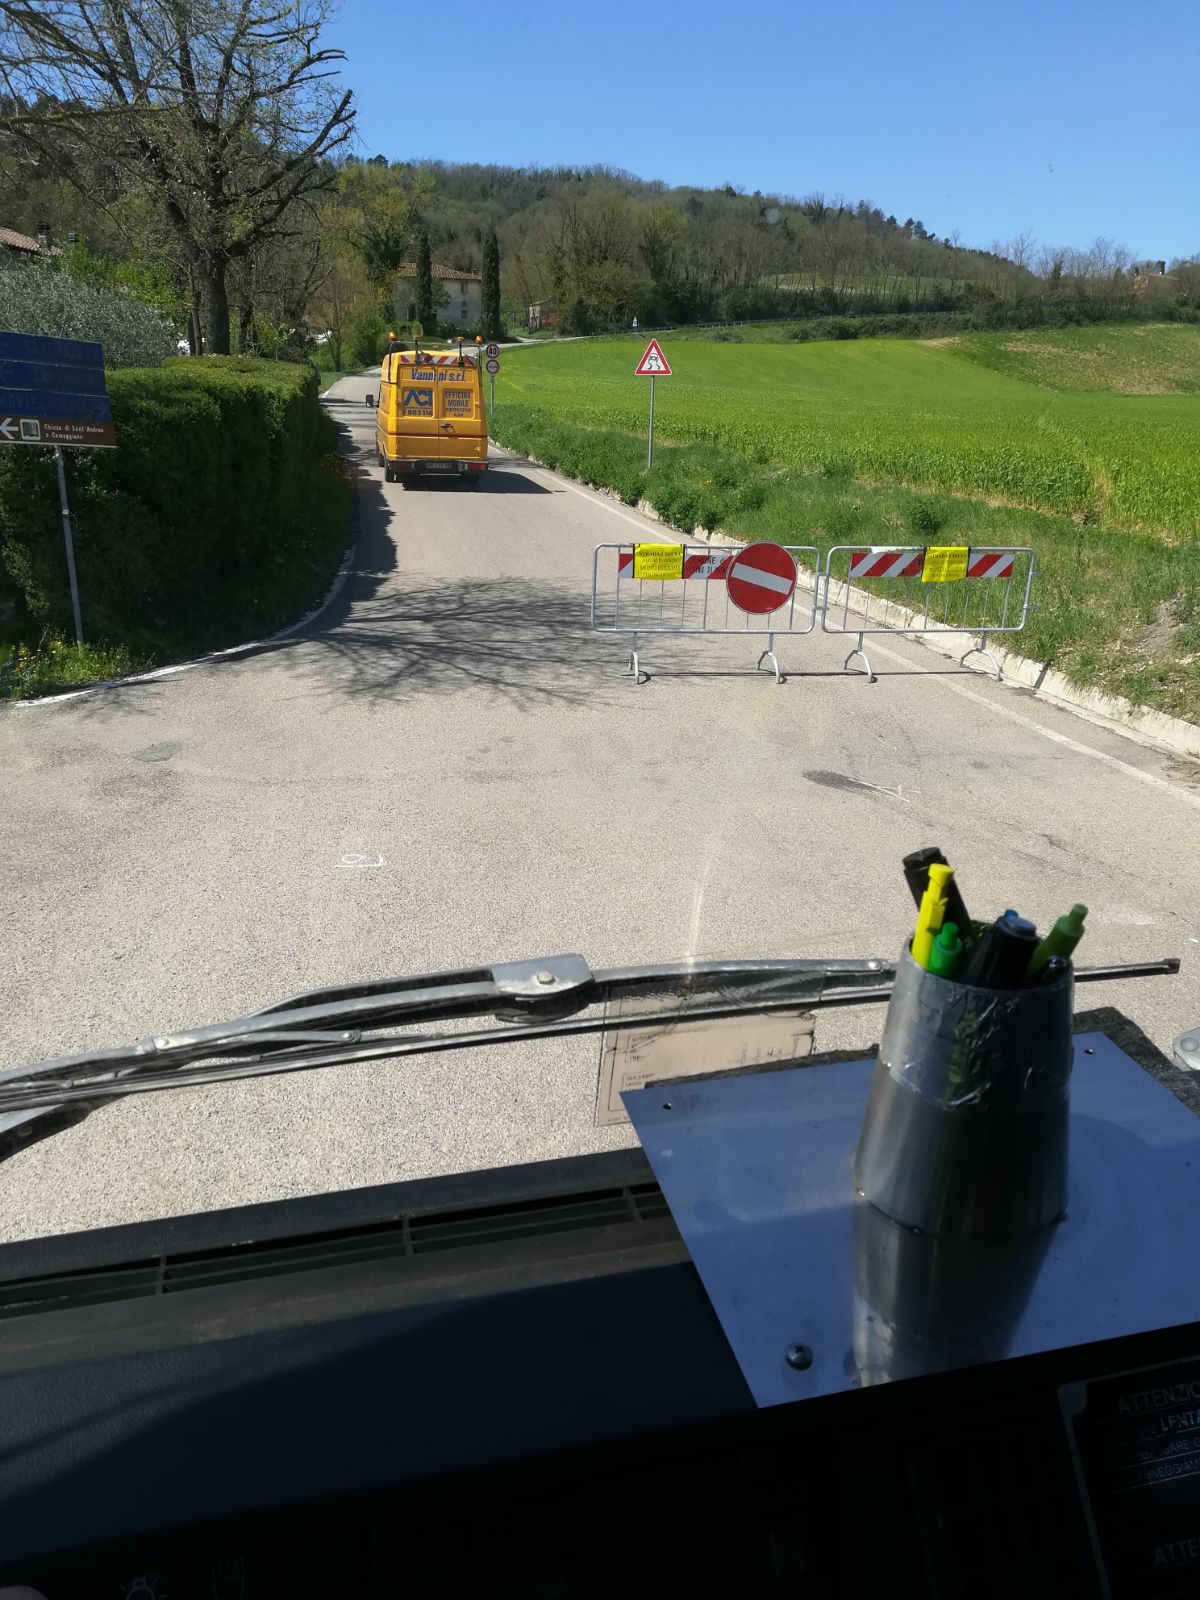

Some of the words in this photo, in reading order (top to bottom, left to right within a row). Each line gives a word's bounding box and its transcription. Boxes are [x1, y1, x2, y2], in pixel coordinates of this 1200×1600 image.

[489, 347, 497, 355] 40
[411, 368, 447, 382] Vannini
[403, 389, 432, 407] ACI
[445, 391, 471, 399] OFFICINA
[447, 399, 469, 407] MOBILE
[44, 423, 62, 431] Chiesa
